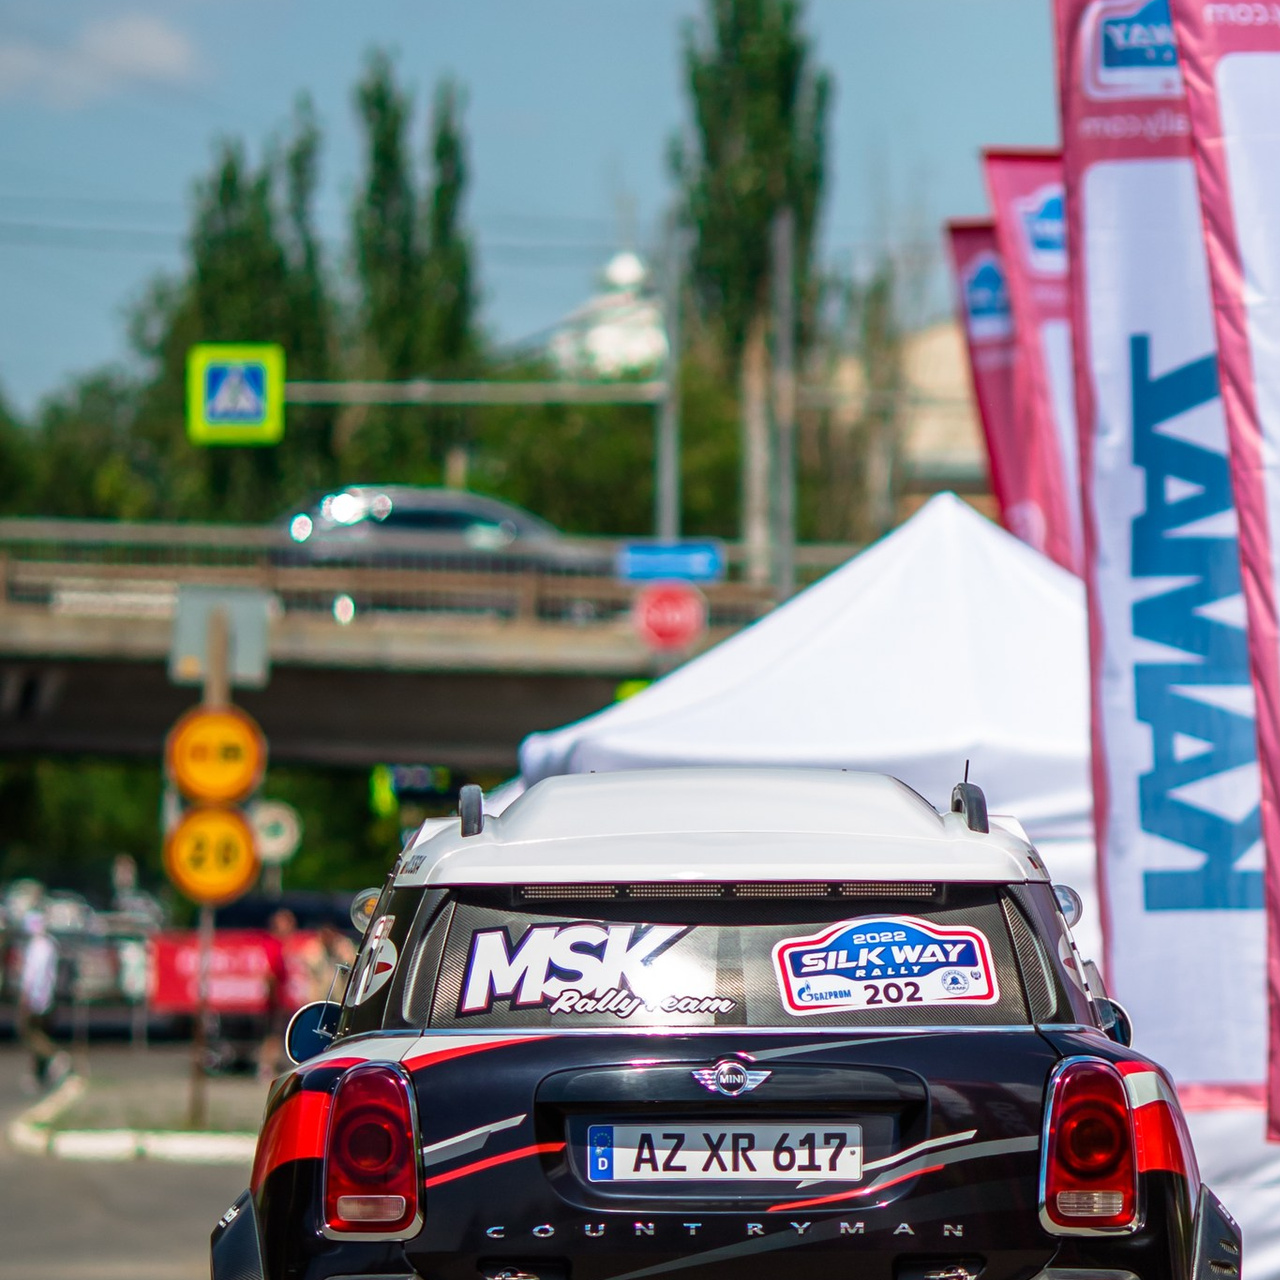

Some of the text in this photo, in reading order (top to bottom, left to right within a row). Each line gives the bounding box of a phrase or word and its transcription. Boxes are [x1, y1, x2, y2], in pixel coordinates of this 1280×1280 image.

[853, 931, 907, 944] 2022
[800, 943, 967, 973] SILK WAY
[461, 925, 688, 1013] MSK
[855, 965, 922, 978] RALLY
[812, 988, 852, 1001] GAZPROM
[864, 981, 923, 1005] 202
[550, 988, 738, 1019] Rally eam
[719, 1075, 744, 1084] MINI
[633, 1133, 847, 1172] AZ XR 617
[598, 1158, 608, 1170] D
[486, 1222, 964, 1238] COUNTRYMAN
